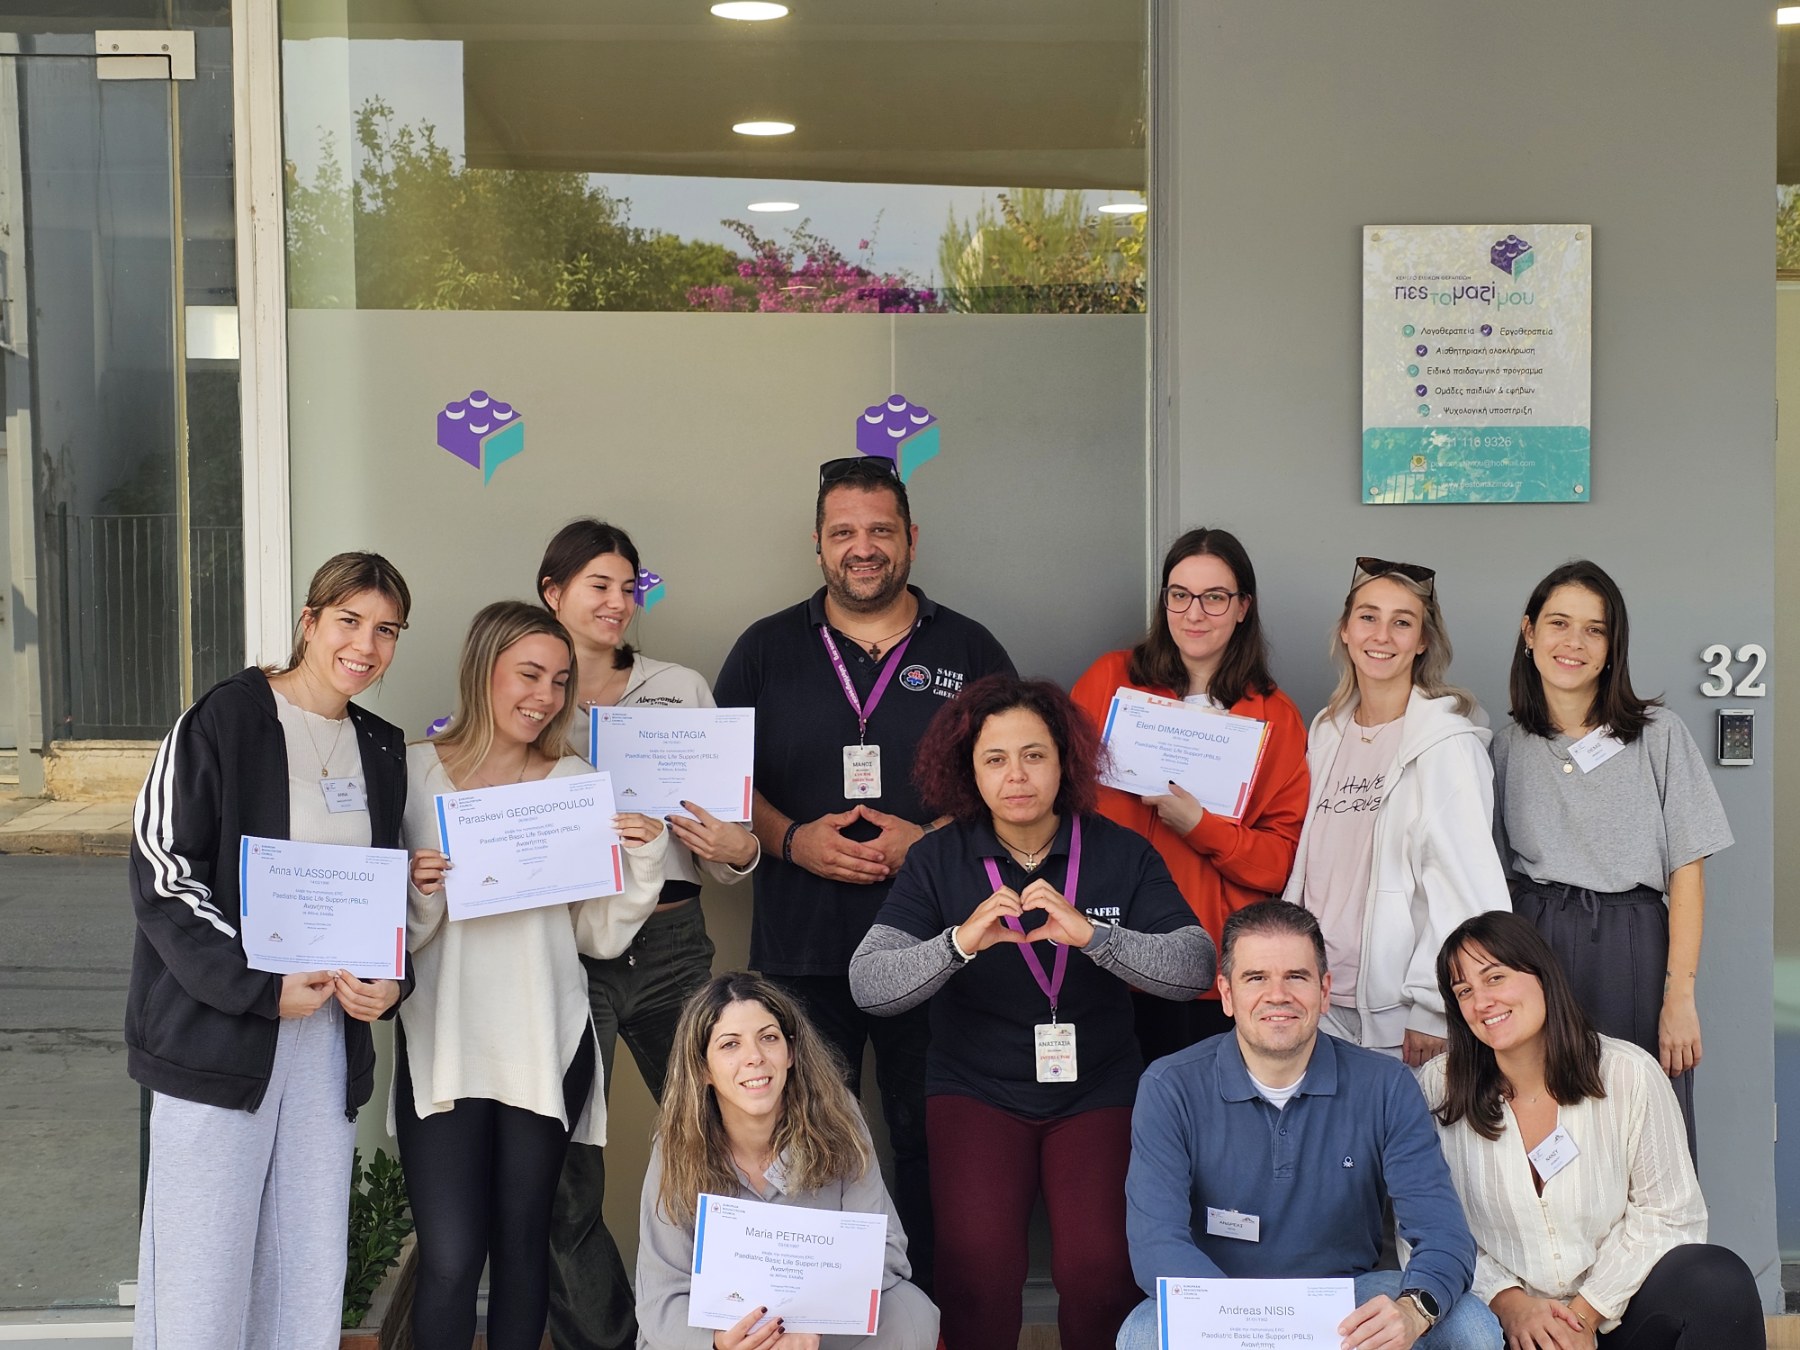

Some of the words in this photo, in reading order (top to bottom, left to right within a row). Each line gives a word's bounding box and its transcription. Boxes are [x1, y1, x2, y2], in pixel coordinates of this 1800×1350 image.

[1421, 328, 1475, 336] Λογοθεραπεία
[1500, 328, 1553, 336] Εργοθεραπεία
[1436, 347, 1488, 356] Αισθητηριακή
[1490, 347, 1536, 355] ολοκλήρωση
[1427, 366, 1451, 375] Ειδικό
[1453, 366, 1500, 375] παιδαγωγικό
[1435, 387, 1464, 396] Ομάδες
[1466, 387, 1496, 395] παιδιών
[1506, 387, 1536, 396] εφήβων
[1443, 407, 1488, 416] Ψυχολογική
[1484, 437, 1512, 447] 9326
[937, 668, 964, 681] SAFER
[1700, 644, 1767, 697] 32
[935, 676, 963, 692] LIFE
[933, 688, 959, 700] GREEC
[636, 696, 684, 704] Abercrombie
[639, 731, 669, 739] Ntorisa
[672, 731, 707, 739] NTAGIA
[1136, 721, 1156, 731] Eleni
[1158, 725, 1230, 744] DIMAKOPOULOU
[1340, 774, 1385, 794] HAVE
[458, 811, 504, 825] Paraskevi
[506, 798, 595, 819] GEORGOPOULOU
[1316, 799, 1332, 814] A
[269, 865, 292, 876] Anna
[294, 867, 375, 882] VLASSOPOULOU
[1085, 906, 1120, 917] SAFER
[746, 1227, 773, 1239] Maria
[776, 1231, 834, 1246] PETRATOU
[795, 1260, 819, 1268] Support
[1219, 1306, 1262, 1316] Andreas
[1265, 1306, 1295, 1316] NISIS
